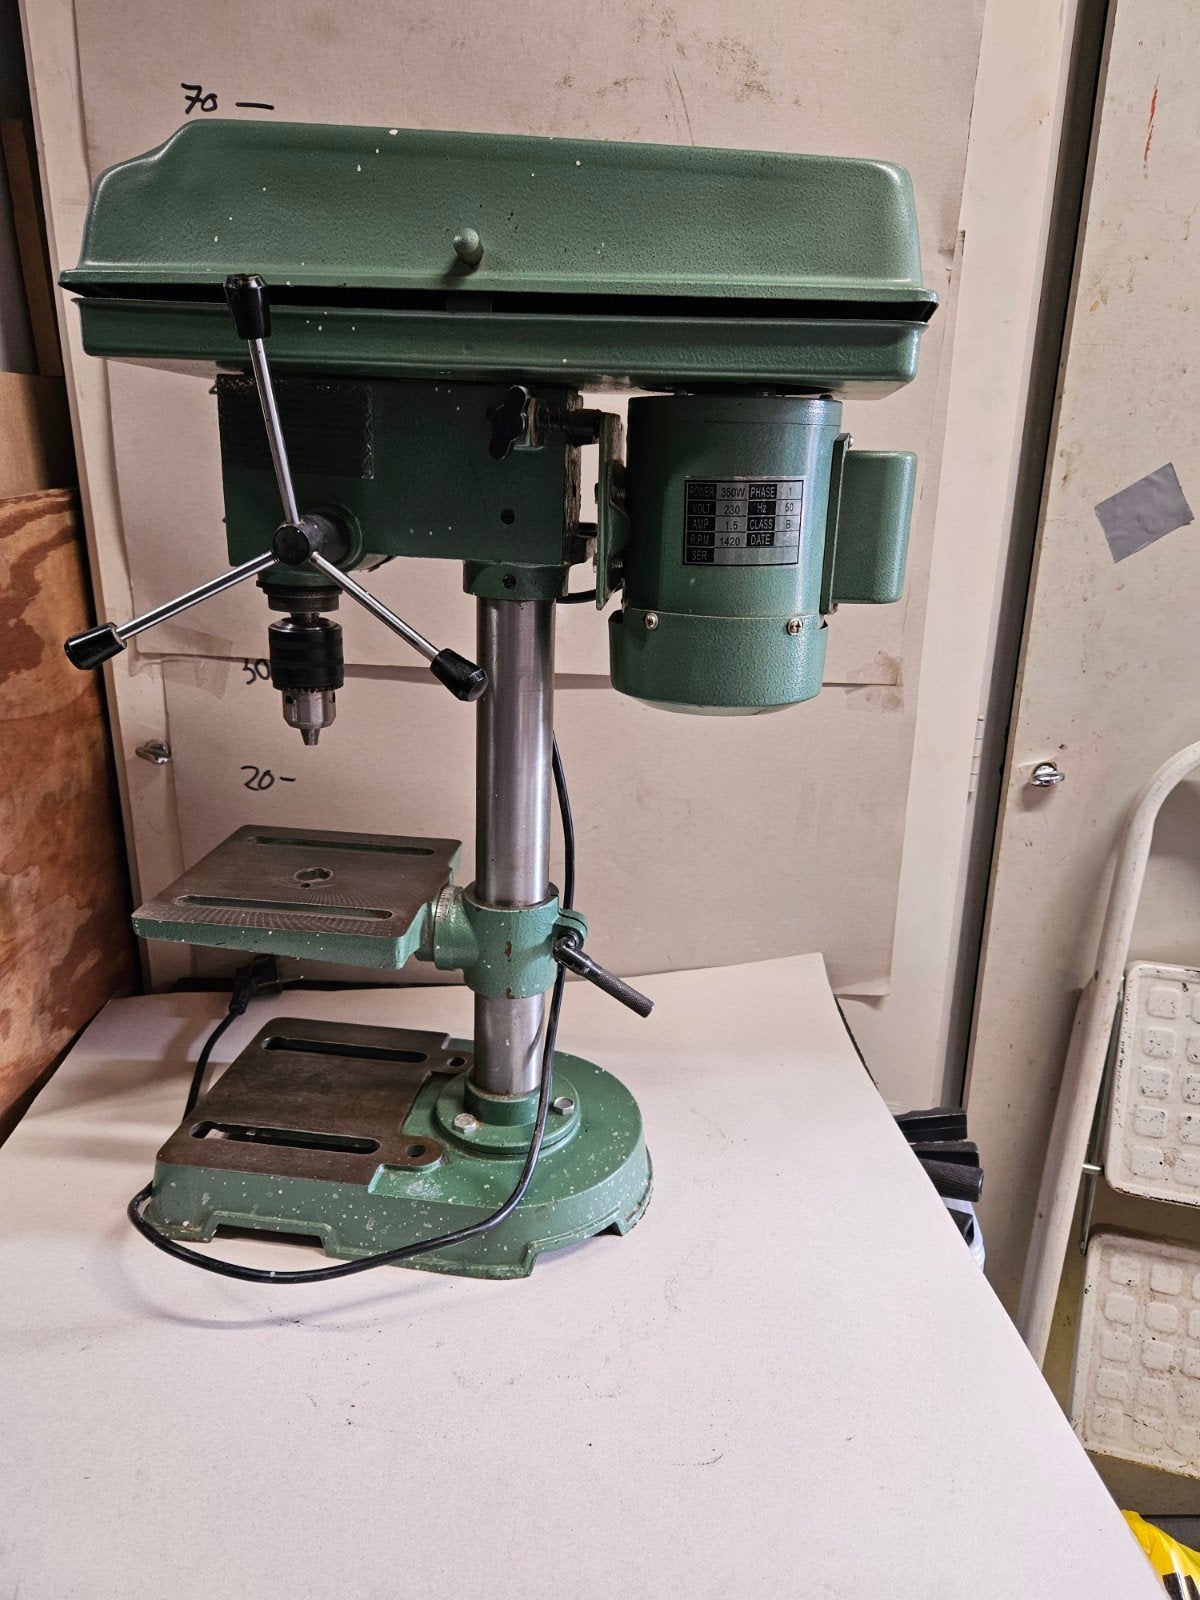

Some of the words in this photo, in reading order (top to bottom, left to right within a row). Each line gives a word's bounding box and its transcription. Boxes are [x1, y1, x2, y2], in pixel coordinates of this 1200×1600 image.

[181, 82, 218, 114] 70
[690, 486, 715, 498] POWER
[721, 487, 746, 498] 350W
[750, 486, 775, 498] PHASE
[692, 503, 711, 514] VOLT
[724, 505, 740, 515] 230
[756, 503, 767, 513] Hz
[784, 503, 794, 512] 50
[692, 519, 709, 529] AMP
[725, 520, 738, 530] 1.5
[750, 519, 773, 530] CLASS
[720, 537, 740, 546] 1420
[750, 534, 770, 545] DATE
